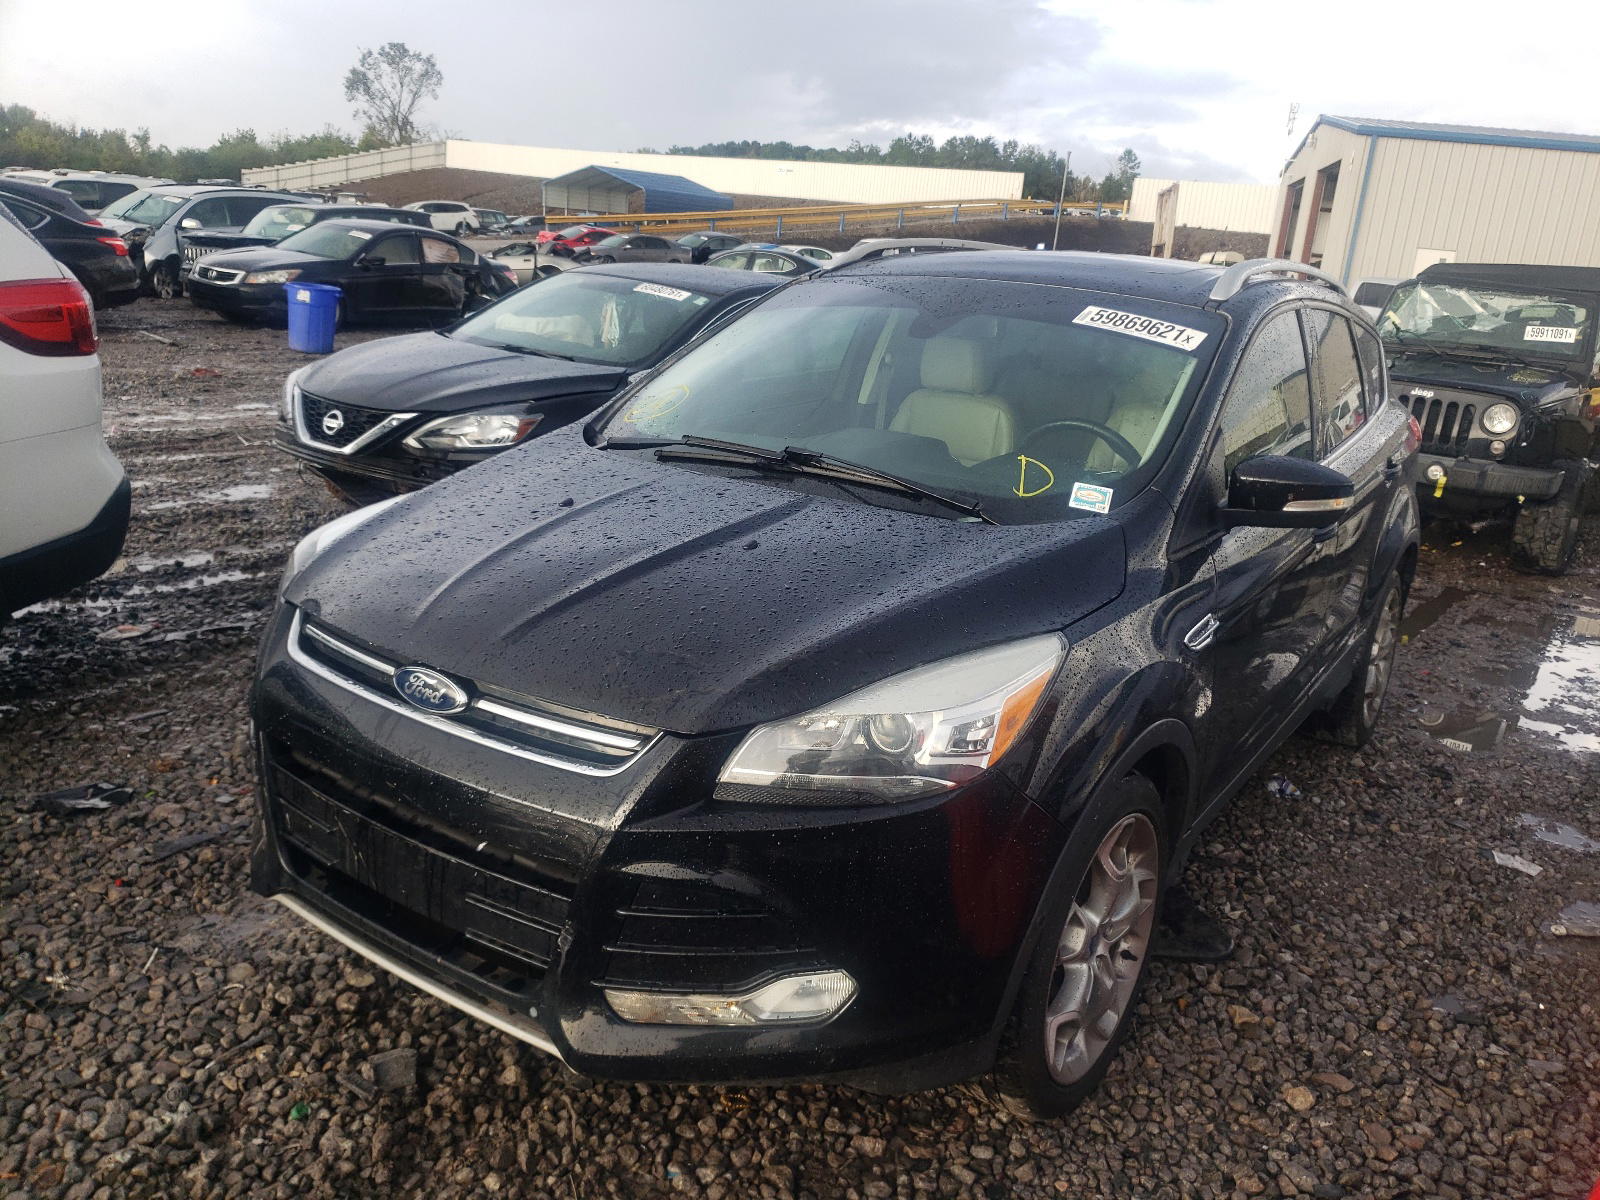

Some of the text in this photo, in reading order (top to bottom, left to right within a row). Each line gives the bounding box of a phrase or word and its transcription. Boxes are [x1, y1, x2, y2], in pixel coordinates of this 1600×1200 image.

[1410, 387, 1434, 398] Jeep
[1013, 455, 1054, 496] D
[404, 672, 447, 704] Ford
